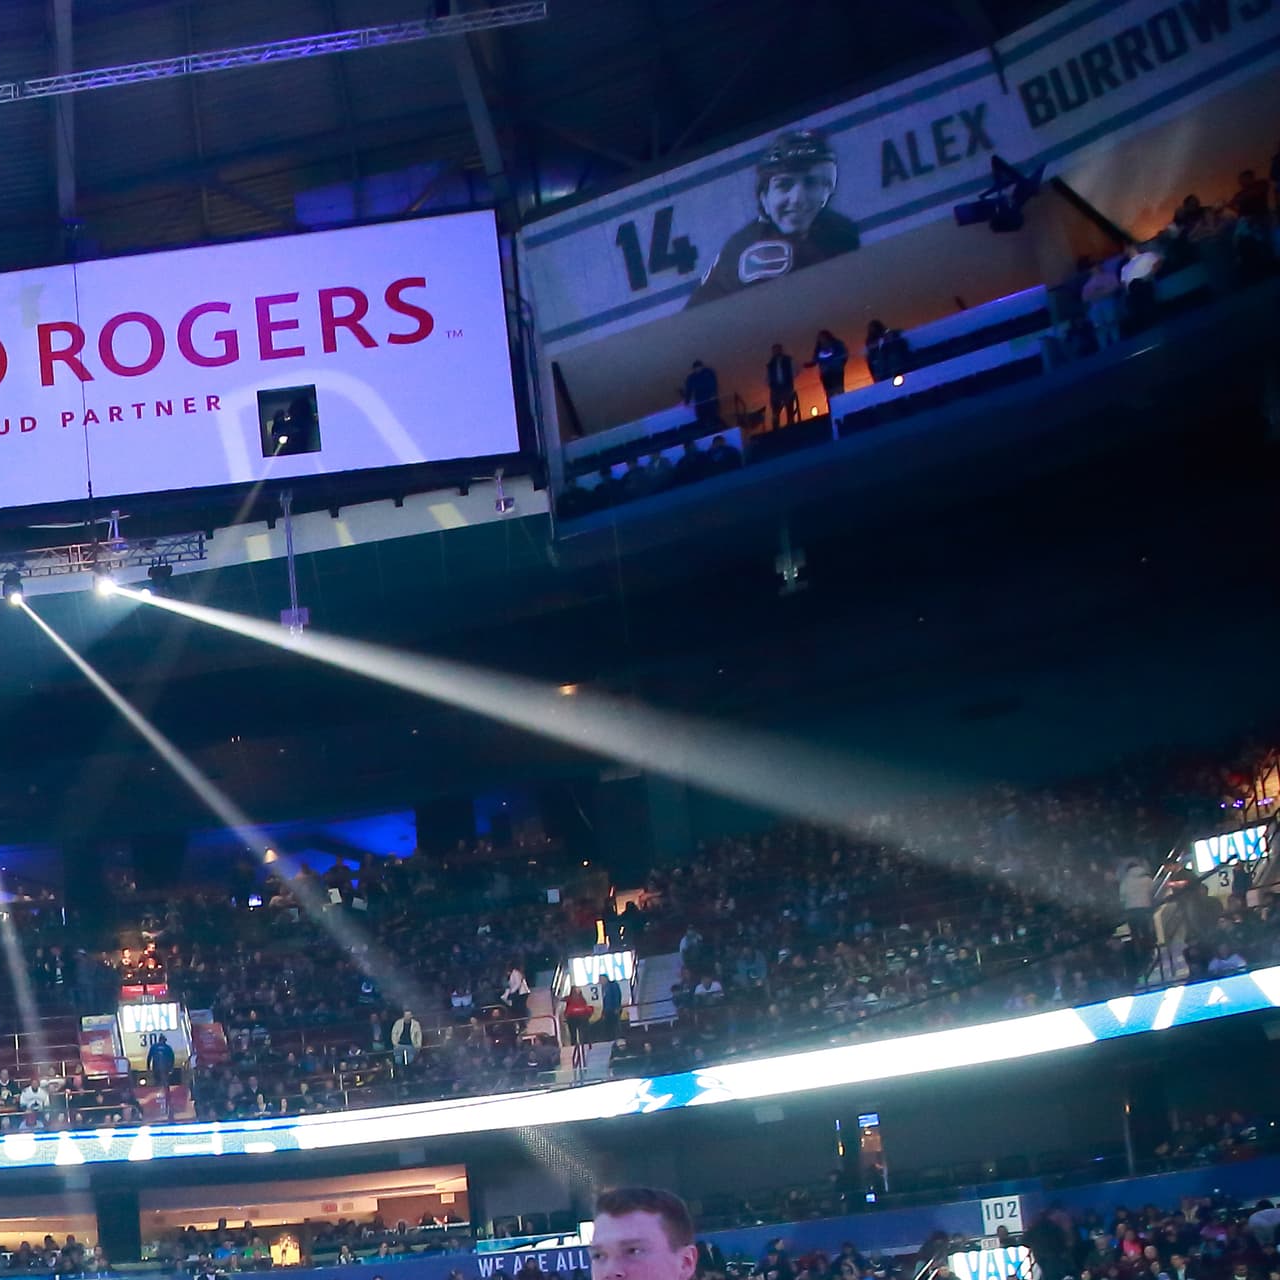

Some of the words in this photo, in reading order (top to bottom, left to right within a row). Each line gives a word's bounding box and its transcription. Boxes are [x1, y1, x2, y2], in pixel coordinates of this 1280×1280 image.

[880, 101, 994, 190] ALEX
[615, 205, 697, 292] 14
[37, 276, 435, 388] ROGERS
[61, 394, 222, 428] PARTNER
[985, 1201, 1018, 1220] 102
[478, 1256, 505, 1278] WE
[556, 1250, 589, 1271] ALL
